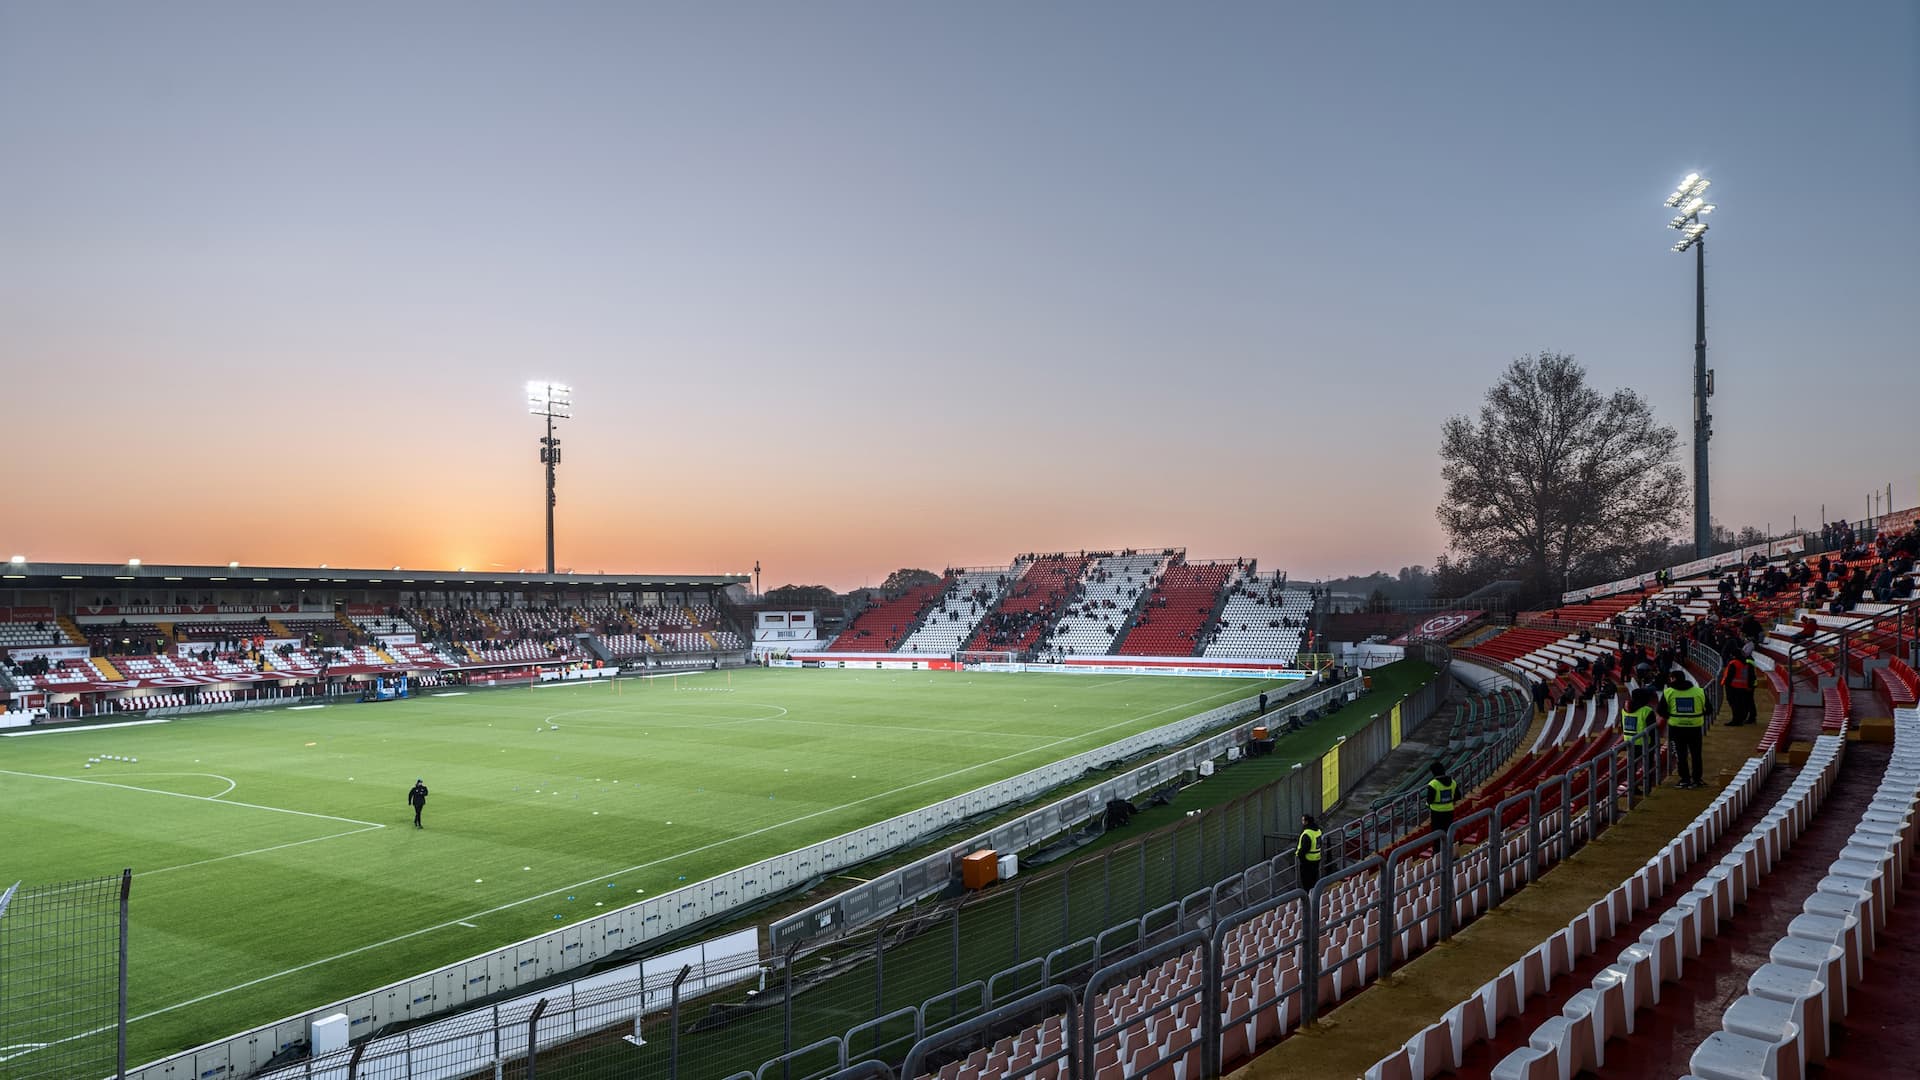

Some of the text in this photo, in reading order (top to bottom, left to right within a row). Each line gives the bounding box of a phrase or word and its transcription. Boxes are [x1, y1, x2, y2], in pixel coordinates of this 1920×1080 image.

[118, 605, 181, 614] MANTOVA 1911
[217, 605, 253, 613] MANTOVA
